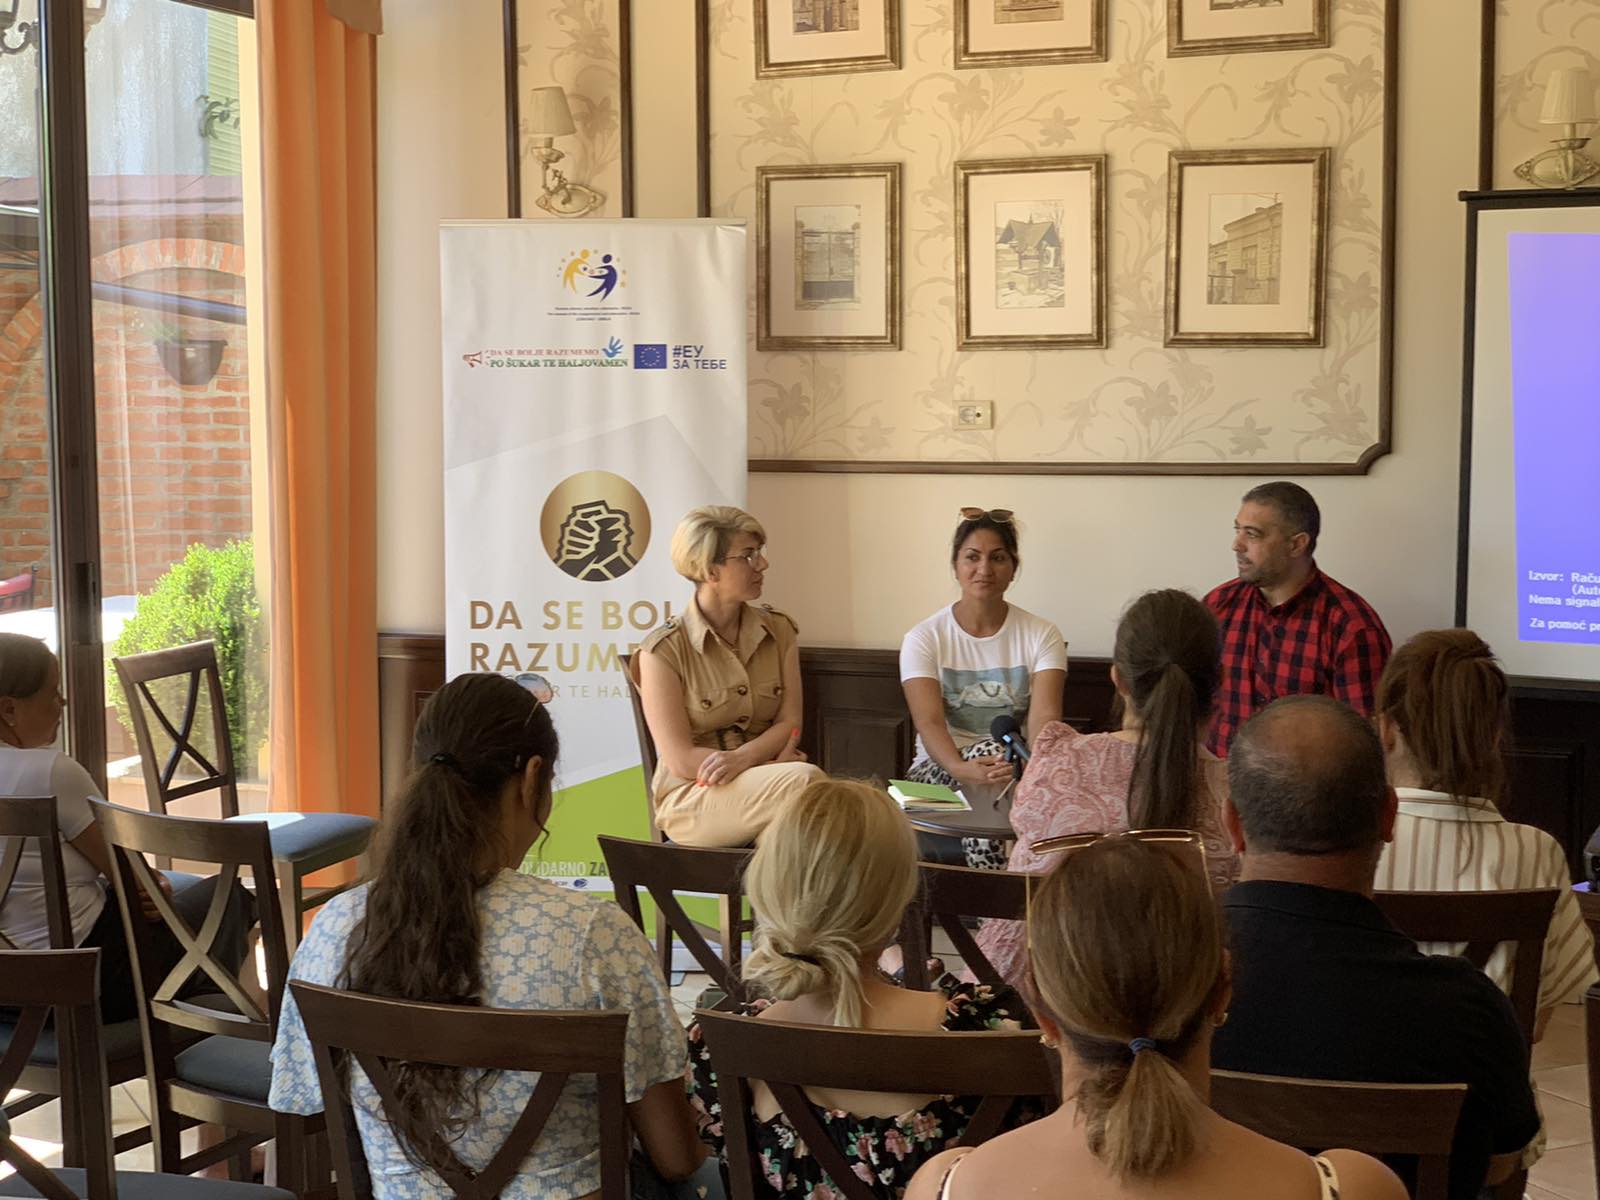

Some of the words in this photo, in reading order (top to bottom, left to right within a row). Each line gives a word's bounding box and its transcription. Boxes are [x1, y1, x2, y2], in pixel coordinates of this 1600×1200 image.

[490, 359, 504, 368] PO
[506, 358, 541, 367] ŠUKAR
[542, 359, 556, 367] TE
[558, 358, 628, 368] HALJOVAMEN
[673, 359, 690, 370] ЗА
[695, 359, 727, 370] ТЕБЕ
[1529, 594, 1561, 605] Nema
[470, 600, 522, 630] DA
[542, 600, 583, 630] SE
[1529, 617, 1545, 628] Za
[1548, 619, 1586, 630] pomoć
[470, 642, 641, 673] RAZUM
[568, 685, 590, 698] TE
